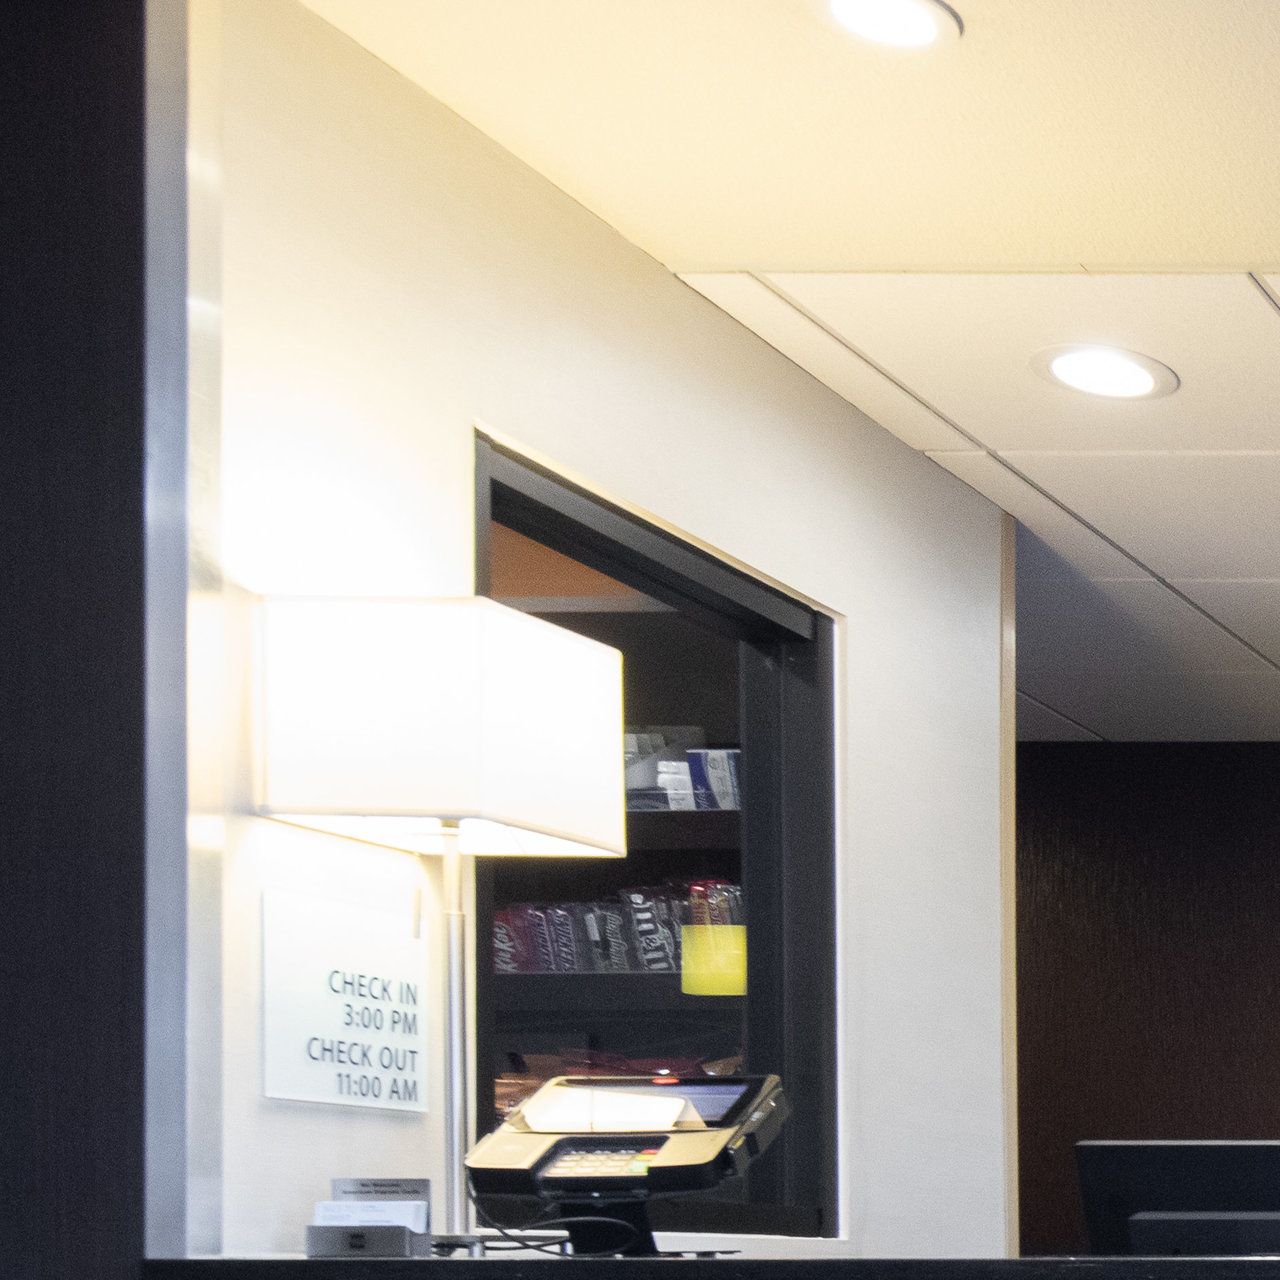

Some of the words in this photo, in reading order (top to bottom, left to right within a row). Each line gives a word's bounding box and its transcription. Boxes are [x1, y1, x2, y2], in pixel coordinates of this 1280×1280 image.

[329, 970, 392, 1002] CHECK
[400, 981, 417, 1005] IN
[344, 1003, 384, 1030] 3:00
[392, 1010, 418, 1035] PM
[307, 1037, 373, 1067] CHECK
[380, 1046, 418, 1072] OUT
[337, 1073, 382, 1098] 11:00
[390, 1078, 418, 1102] AM
